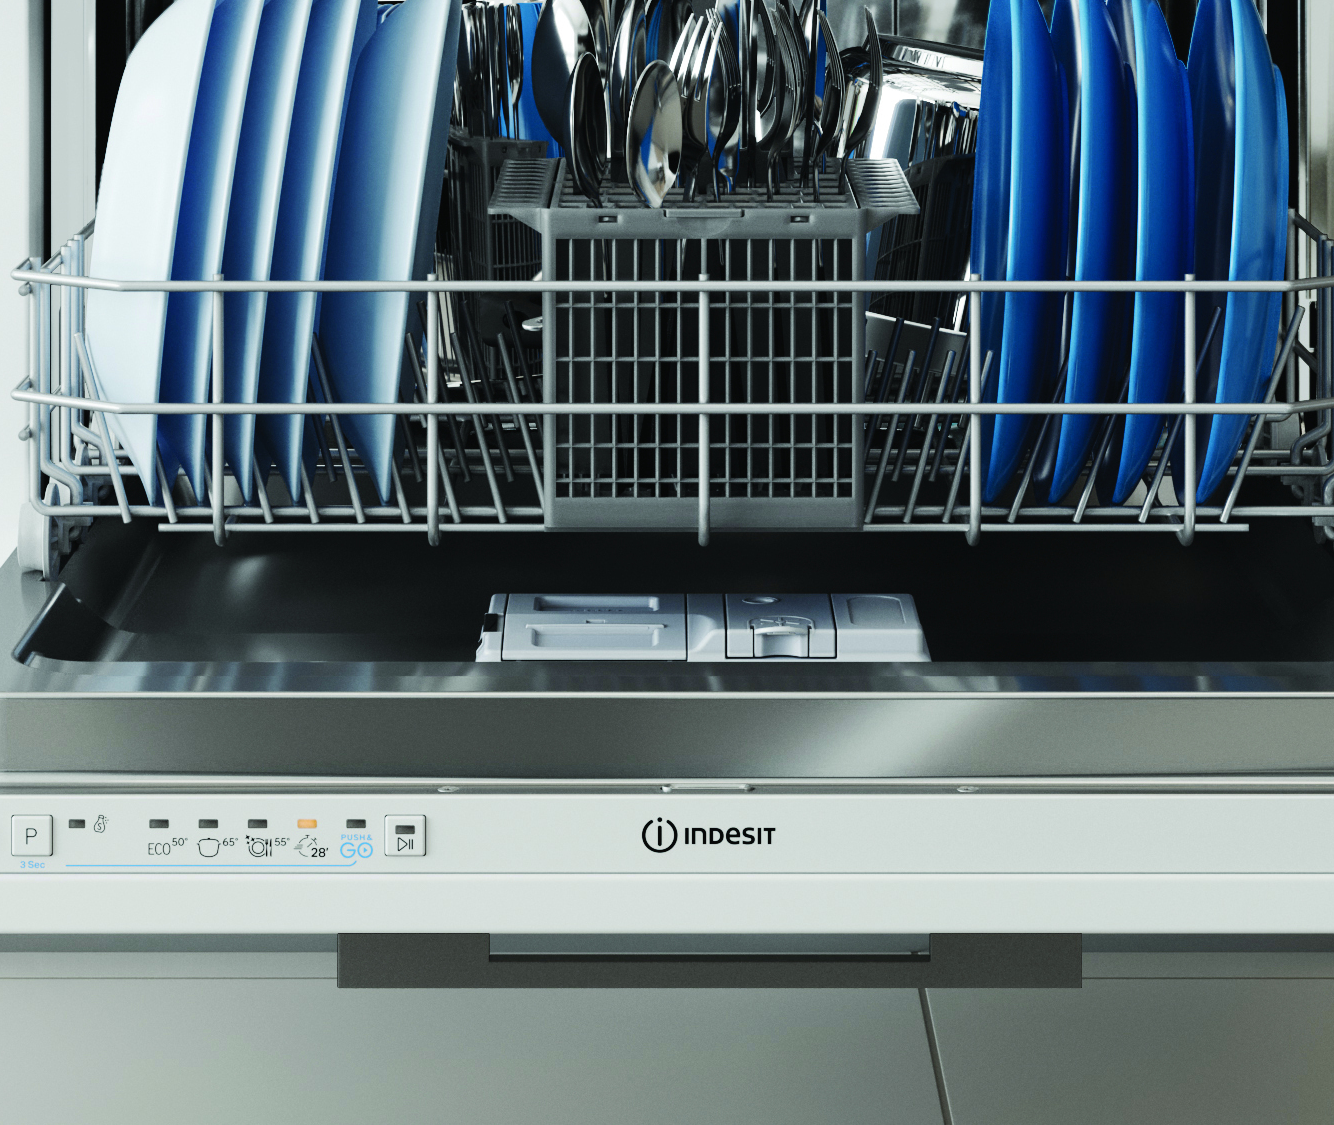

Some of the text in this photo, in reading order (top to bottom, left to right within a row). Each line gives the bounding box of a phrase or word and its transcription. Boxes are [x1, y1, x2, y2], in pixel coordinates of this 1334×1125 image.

[25, 827, 38, 845] P
[222, 837, 239, 847] 65°
[684, 827, 776, 845] INDESIT
[147, 842, 171, 856] ECO
[340, 842, 374, 859] GO
[19, 860, 46, 869] 3 Sec
